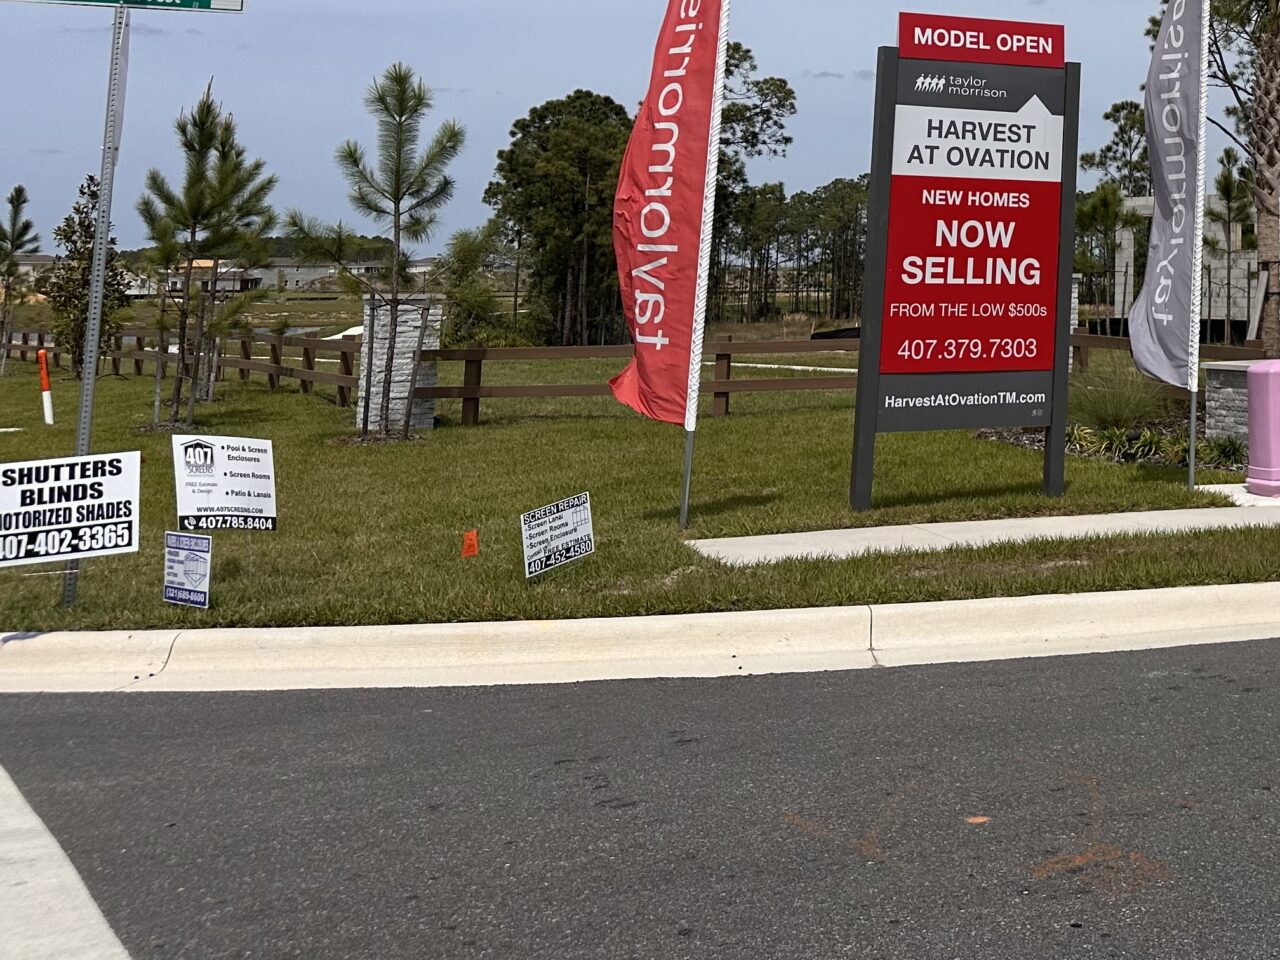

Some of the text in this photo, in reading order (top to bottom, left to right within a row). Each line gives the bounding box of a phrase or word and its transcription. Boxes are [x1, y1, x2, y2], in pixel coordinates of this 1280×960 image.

[914, 26, 1053, 54] MODEL OPEN
[948, 86, 1007, 98] morrison
[949, 75, 987, 90] taylor
[926, 118, 1036, 144] HARVEST
[906, 144, 1050, 171] AT OVATION
[921, 189, 1030, 208] NEW HOMES
[935, 219, 1016, 248] NOW
[901, 255, 1041, 286] SELLING
[889, 302, 1048, 318] FROM THE LOW $500s
[897, 338, 1038, 360] 407.379.7303
[884, 391, 1046, 409] HarvestAtOvationTM.com
[186, 447, 212, 465] 407
[226, 444, 241, 452] Pool
[247, 445, 268, 453] Screen
[227, 454, 260, 463] Enclosures
[2, 458, 122, 487] SHUTTERS
[187, 464, 214, 474] SCREENS
[229, 470, 271, 480] Screen Rooms
[20, 481, 104, 507] BLINDS
[0, 499, 132, 532] OTORIZED SHADES
[524, 495, 587, 524] SCREEN REPAIR
[198, 516, 273, 530] 407.785.8404
[529, 541, 591, 573] 407-452-4580
